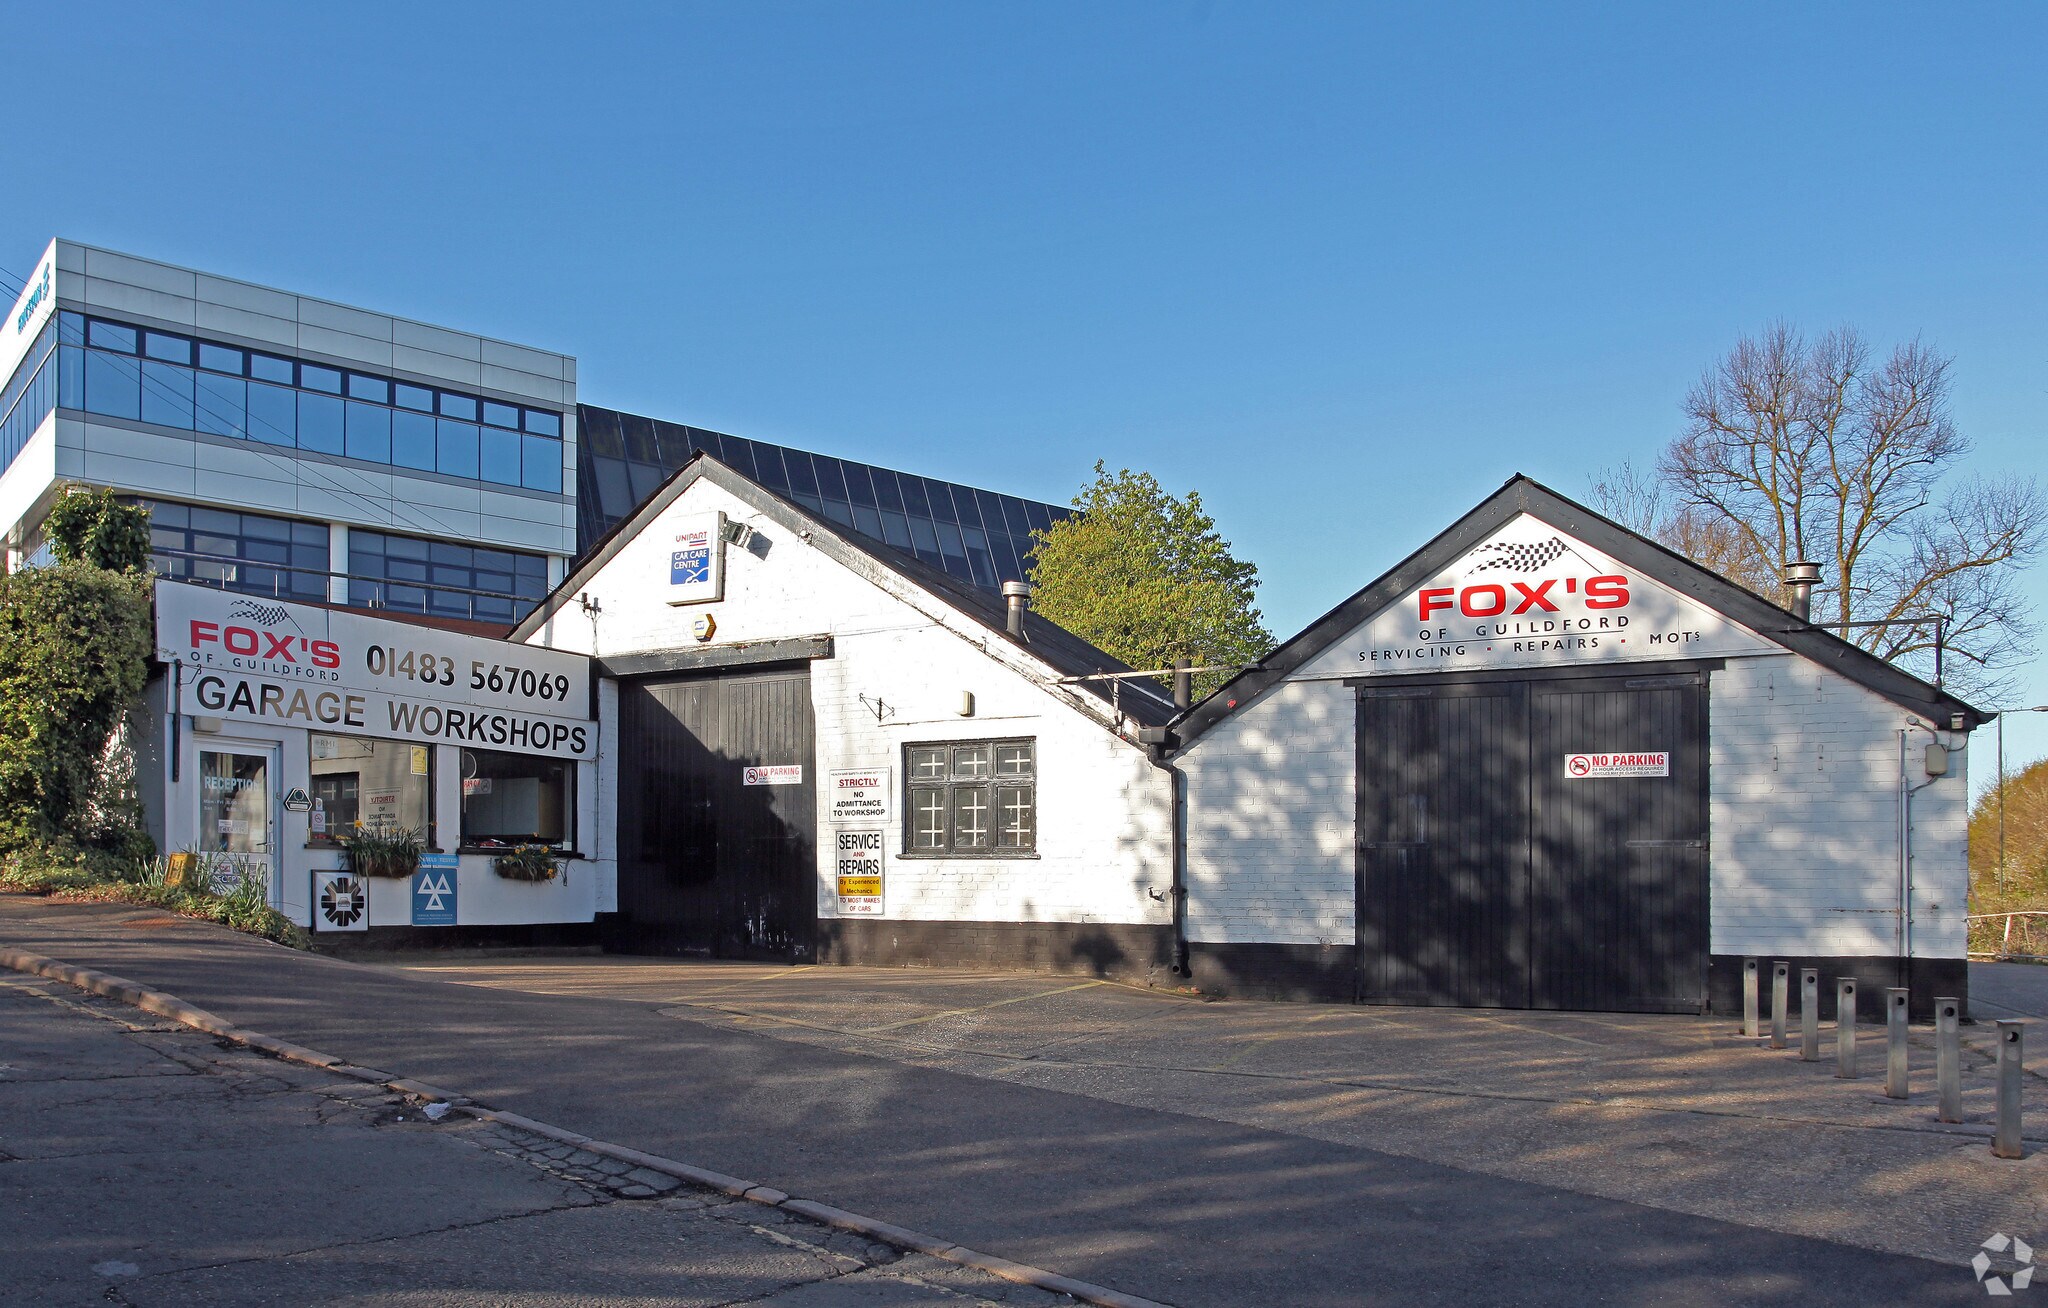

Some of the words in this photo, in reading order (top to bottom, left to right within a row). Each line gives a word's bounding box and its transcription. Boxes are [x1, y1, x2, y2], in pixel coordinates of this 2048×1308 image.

[676, 532, 707, 542] UNIPART
[675, 552, 688, 561] CAR
[690, 550, 707, 558] CARE
[674, 560, 700, 570] CENTRE
[1419, 575, 1630, 621] FOX'S
[1419, 628, 1447, 641] OF
[1475, 615, 1629, 637] GUILDFORD
[190, 619, 341, 669] FOX'S
[1359, 645, 1466, 662] SERVICING
[1513, 637, 1599, 652] REPAIRS
[190, 651, 213, 663] OF
[232, 657, 339, 682] GUILDFORD
[366, 645, 455, 686] 01483
[470, 660, 570, 702] 567069
[196, 675, 366, 728] GARAGE
[388, 701, 587, 754] WORKSHOPS
[1592, 755, 1608, 766] NO
[1613, 754, 1664, 766] PARKING
[759, 768, 768, 777] NO
[770, 767, 800, 776] PARKING
[204, 775, 260, 791] RECEPTION
[839, 778, 878, 787] STRICTLY
[845, 808, 886, 816] WORKSHOP
[839, 834, 880, 850] SERVICE
[839, 859, 880, 875] REPAIRS
